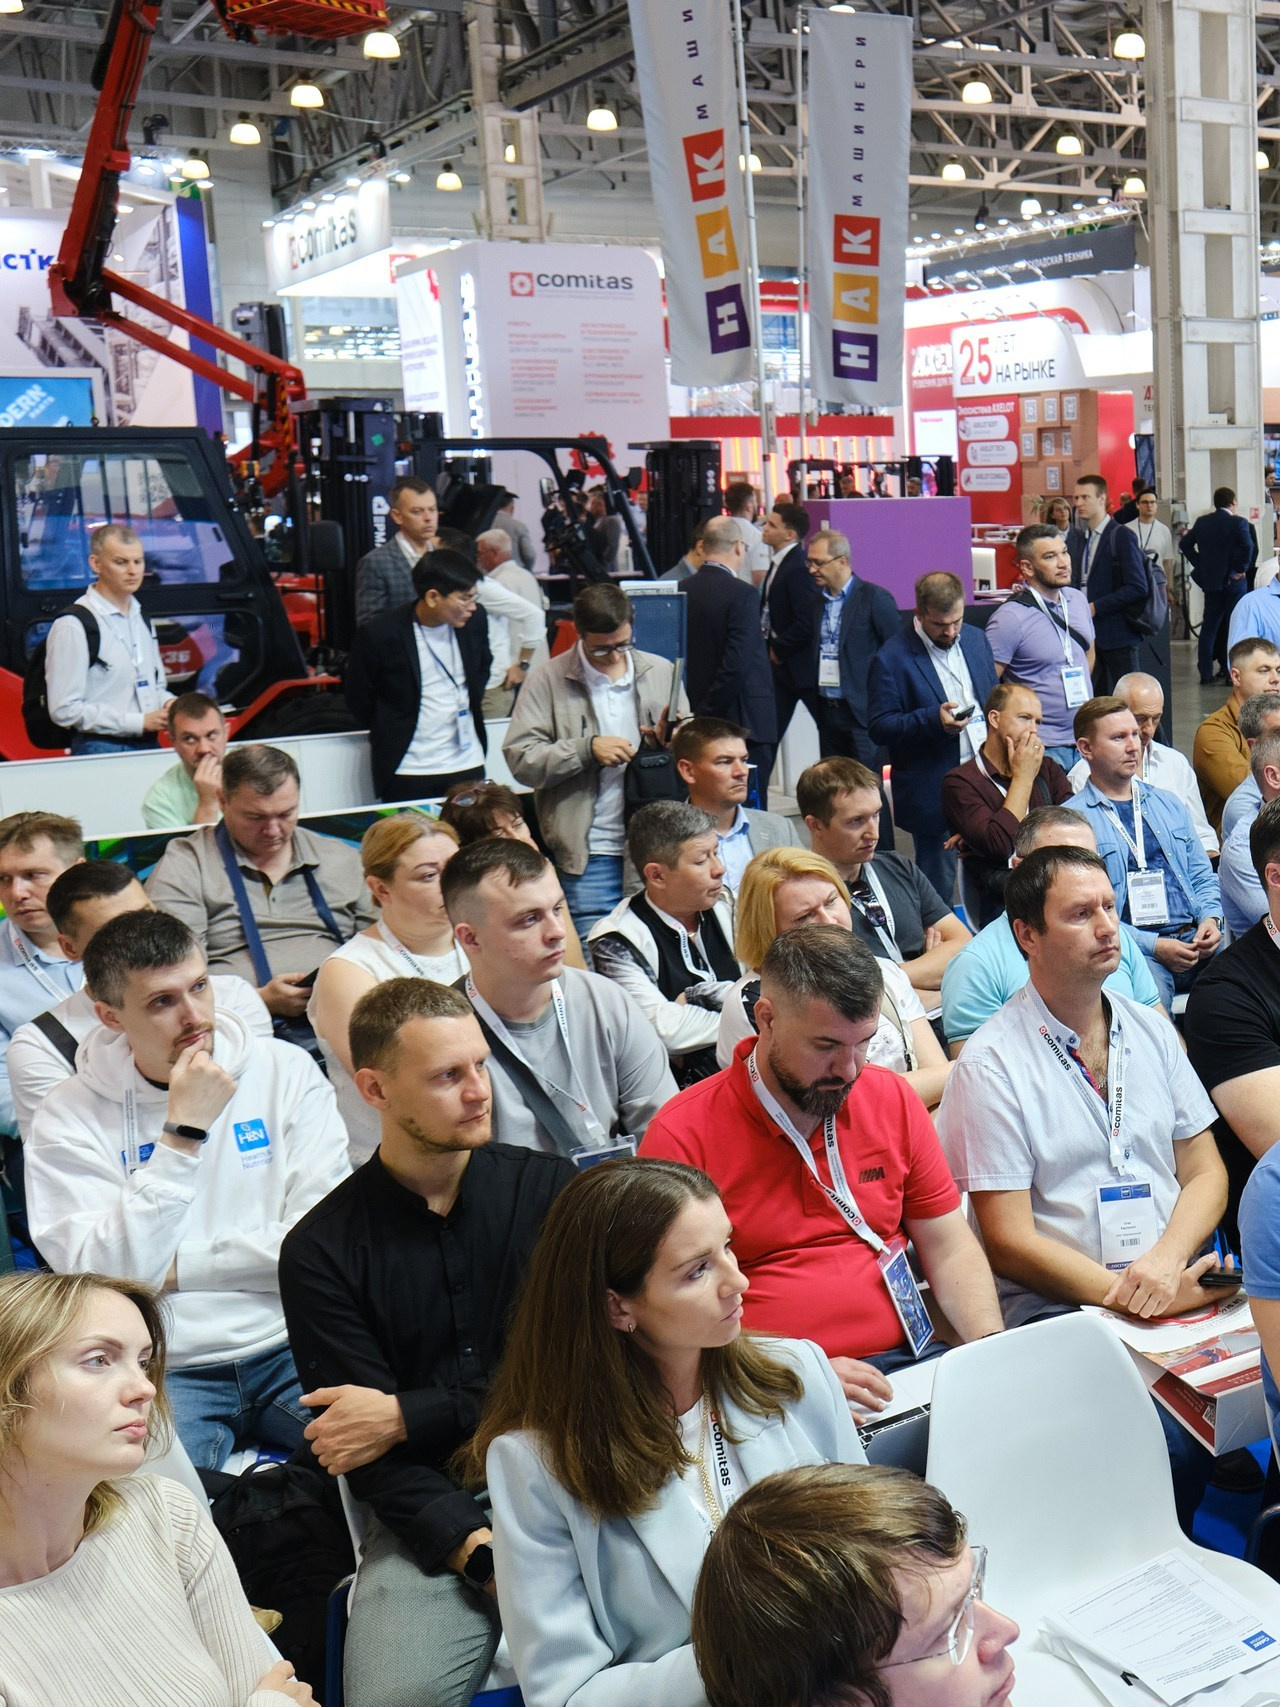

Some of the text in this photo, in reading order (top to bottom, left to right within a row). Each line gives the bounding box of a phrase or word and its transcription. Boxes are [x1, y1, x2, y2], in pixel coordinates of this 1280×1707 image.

[683, 9, 738, 337] НАК МАШИ
[840, 36, 872, 369] НАК МАШИНЕРИ
[536, 272, 633, 290] comitas
[959, 337, 993, 385] 25
[996, 362, 1012, 384] НА
[1014, 359, 1056, 381] РЫНКЕ
[992, 401, 1015, 413] AXELOT
[1043, 1033, 1072, 1071] comitas
[1114, 1086, 1123, 1129] comitas
[825, 1116, 835, 1148] mitas
[240, 1153, 265, 1163] Health
[712, 1422, 731, 1487] comitas
